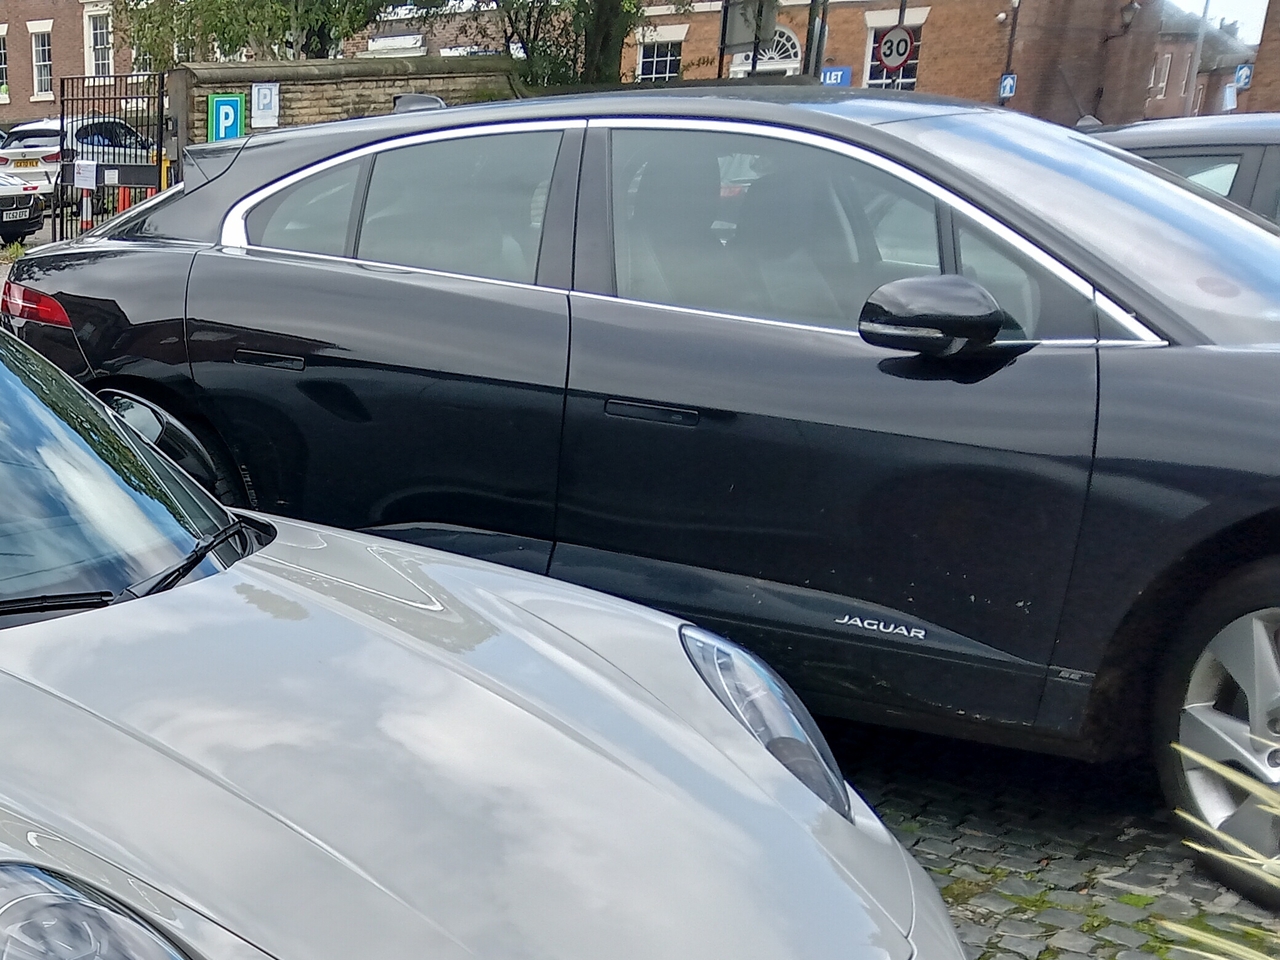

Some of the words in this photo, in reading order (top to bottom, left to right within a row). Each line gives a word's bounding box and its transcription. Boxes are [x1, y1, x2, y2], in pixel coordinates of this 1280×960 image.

[882, 38, 909, 58] 30
[826, 71, 844, 84] LET
[259, 88, 272, 110] P
[219, 105, 235, 138] P
[834, 614, 927, 640] JAGUAR
